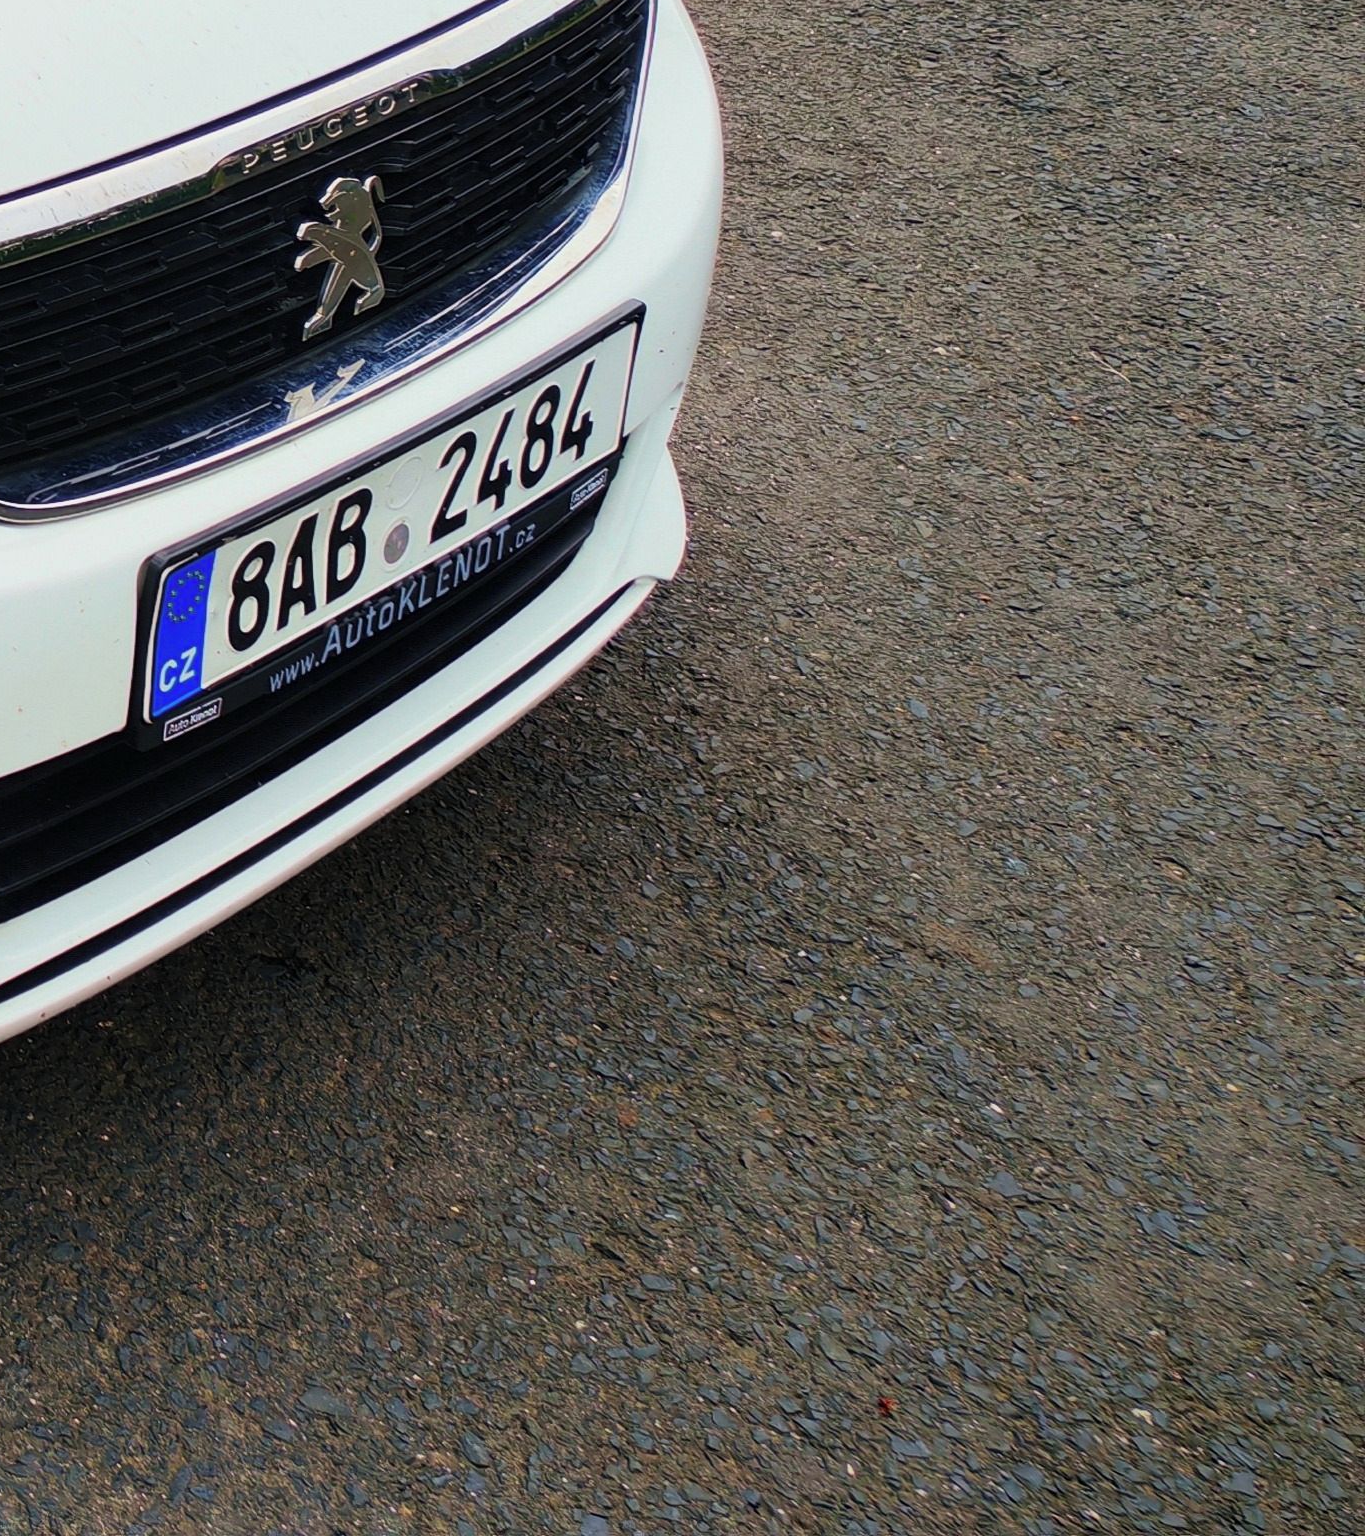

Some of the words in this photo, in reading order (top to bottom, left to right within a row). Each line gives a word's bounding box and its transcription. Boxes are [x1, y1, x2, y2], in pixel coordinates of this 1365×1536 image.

[242, 82, 419, 174] PEUGEOT
[227, 488, 373, 652] 8AB
[430, 359, 596, 544] 2484
[159, 646, 197, 693] CZ
[269, 524, 536, 693] www.AutoKLENOT.cz
